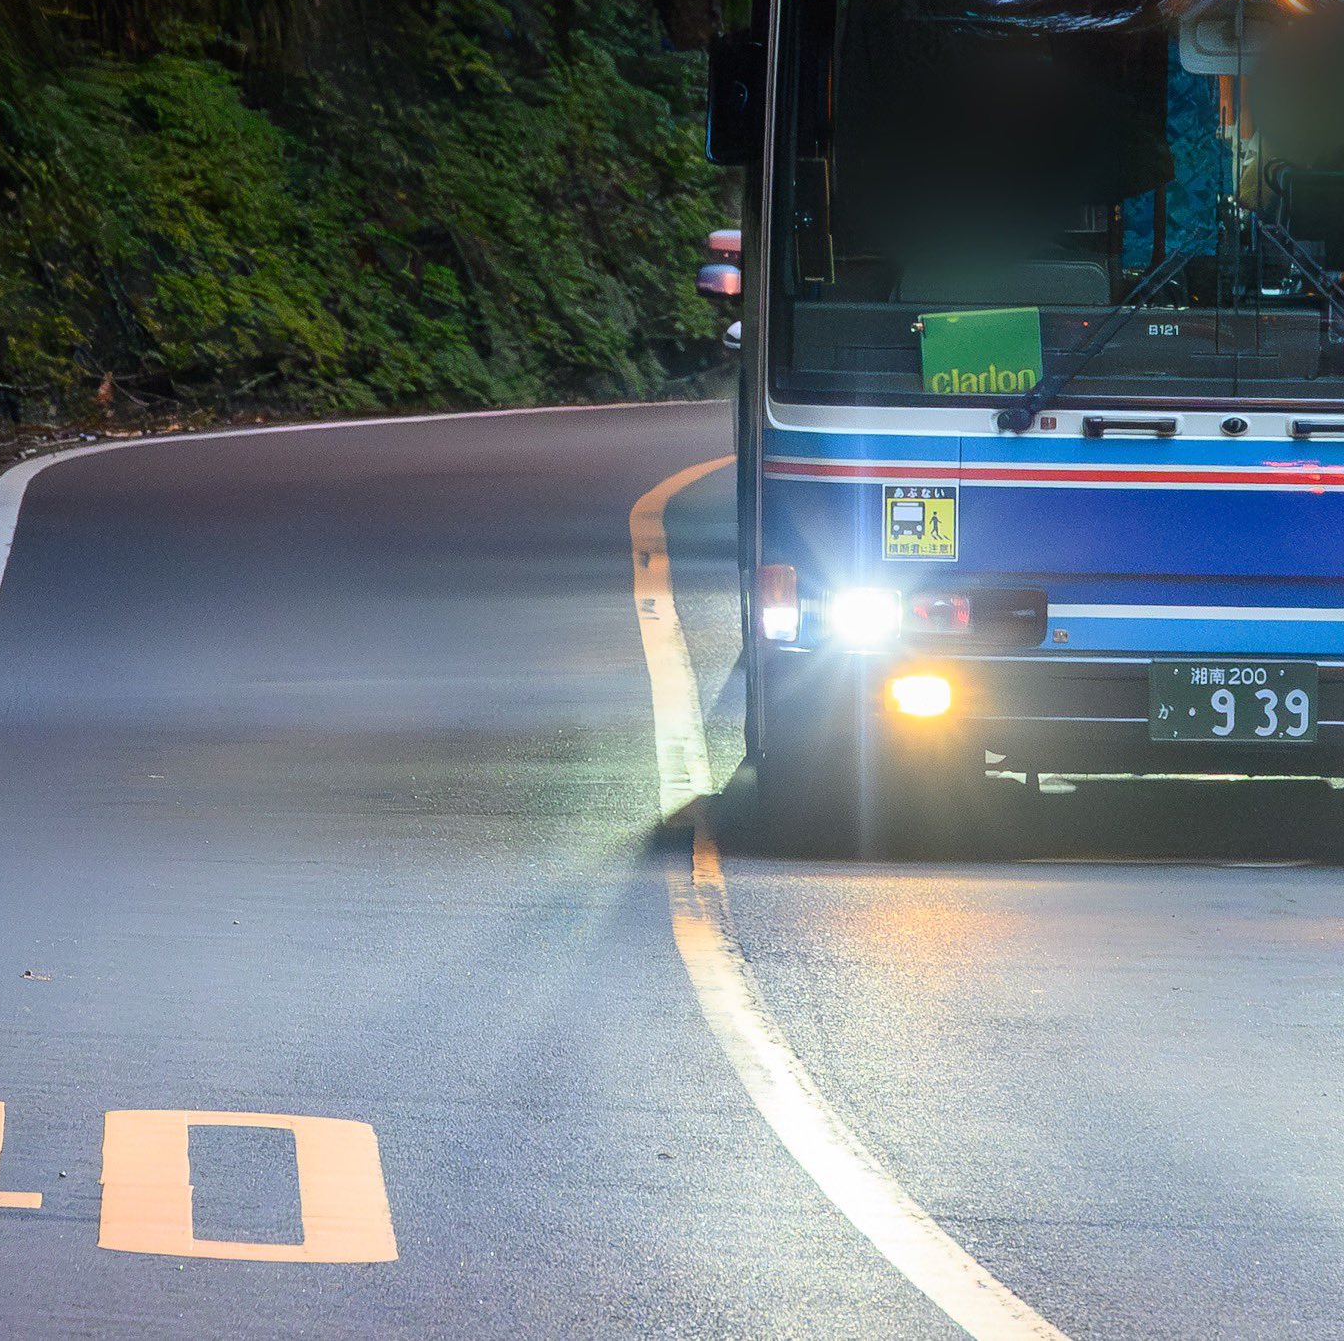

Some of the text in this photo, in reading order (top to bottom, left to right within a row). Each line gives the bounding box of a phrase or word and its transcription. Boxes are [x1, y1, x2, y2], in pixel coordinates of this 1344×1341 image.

[1148, 324, 1179, 336] B121
[931, 362, 1038, 394] clarion
[893, 487, 946, 499] あぶない
[1190, 667, 1268, 686] 湘南200
[1157, 703, 1175, 720] か
